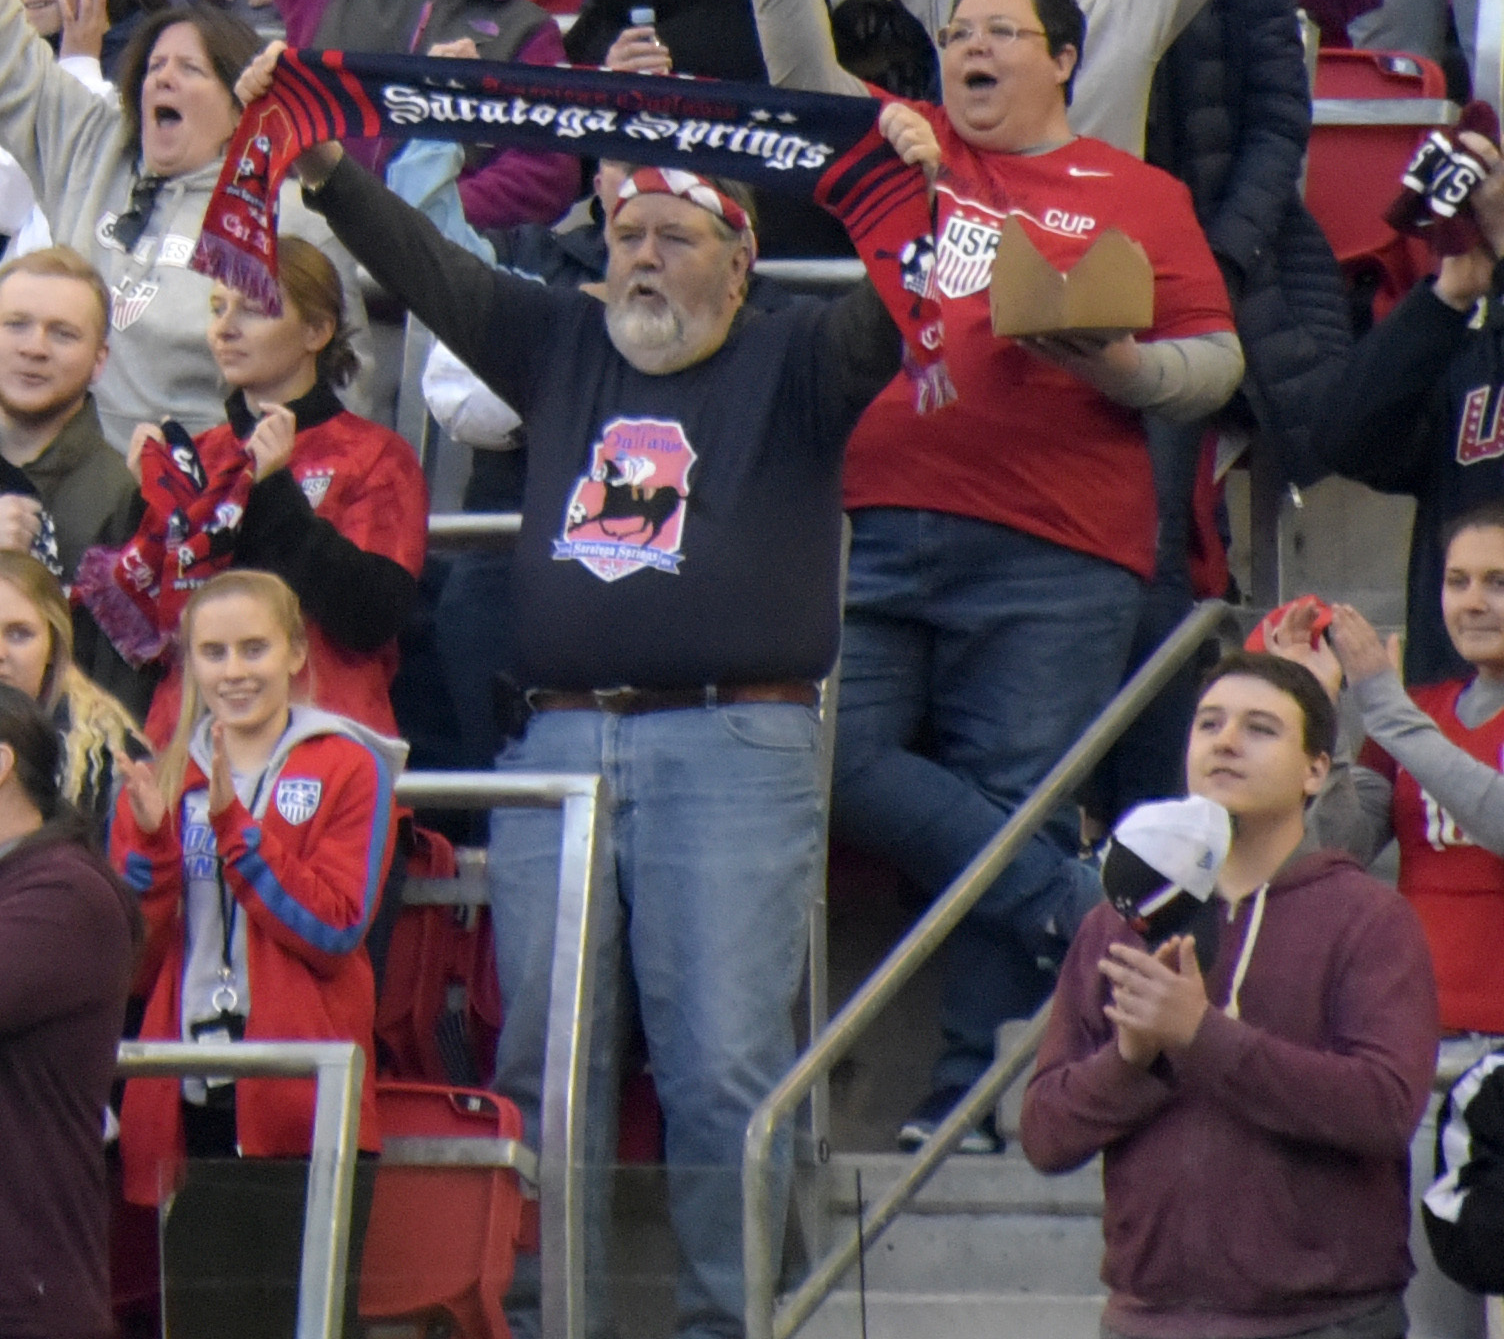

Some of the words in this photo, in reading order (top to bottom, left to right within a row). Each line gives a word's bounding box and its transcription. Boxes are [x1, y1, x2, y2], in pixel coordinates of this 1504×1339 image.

[382, 83, 618, 140] Saratoga
[626, 107, 836, 172] Springs
[1044, 208, 1096, 235] CUP
[573, 540, 615, 560] Saratoga
[616, 544, 661, 564] Springs
